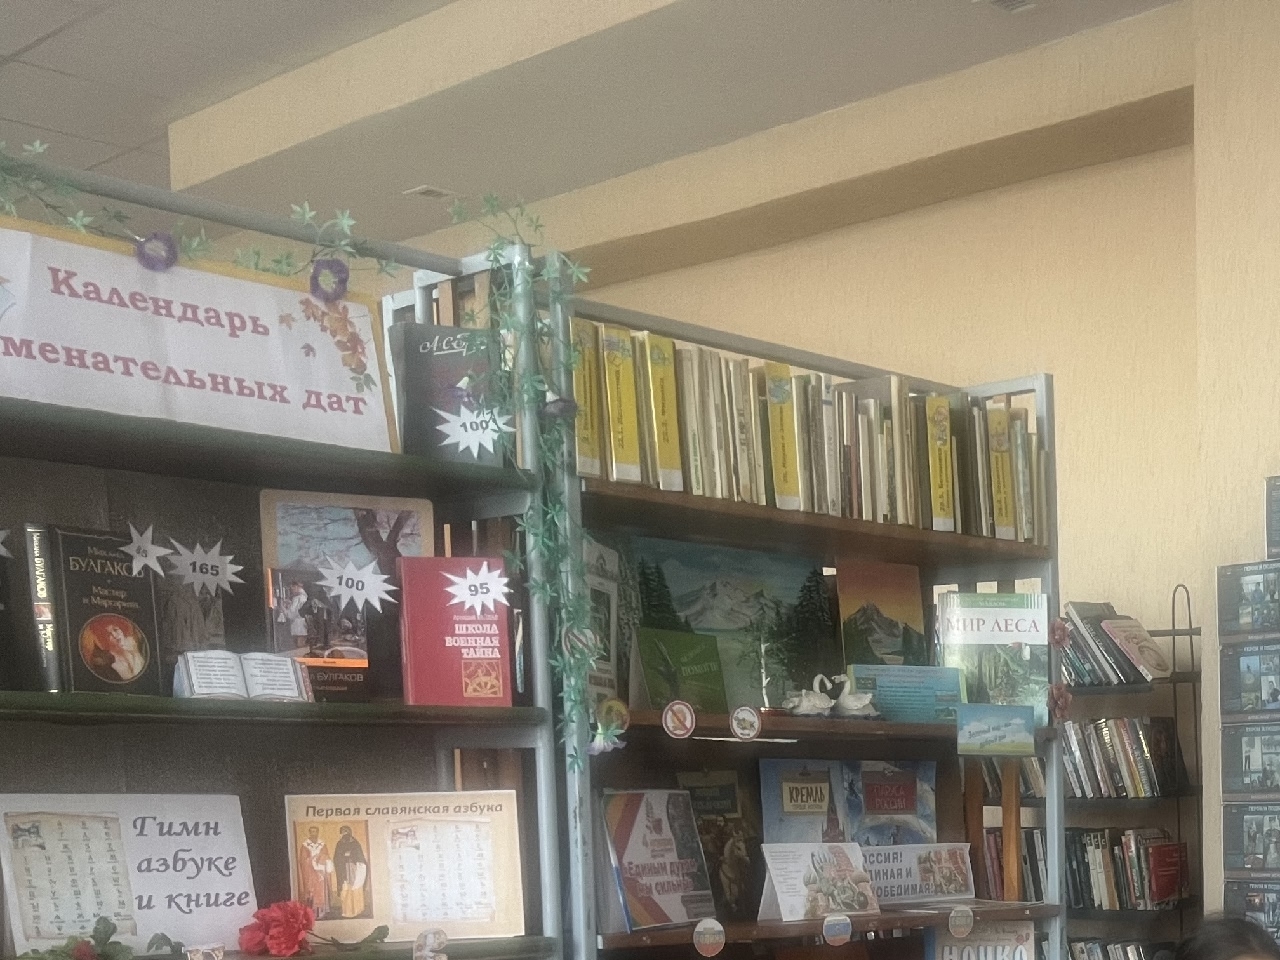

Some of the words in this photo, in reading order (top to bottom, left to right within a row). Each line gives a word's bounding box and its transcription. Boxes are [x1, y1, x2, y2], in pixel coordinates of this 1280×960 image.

[47, 266, 270, 338] Календарь
[302, 389, 367, 415] дат
[460, 420, 489, 434] 100
[69, 556, 144, 578] БУЛГАКВ
[189, 560, 220, 577] 165
[336, 574, 366, 592] 100
[467, 581, 491, 598] 95
[454, 624, 499, 635] ШКОЛА
[946, 617, 985, 632] МИР
[990, 618, 1040, 633] ЛЕСА
[445, 636, 500, 648] ВОЕННАЯ
[461, 647, 501, 659] ТАЙНА
[316, 672, 364, 683] БУЛГАКОВ
[788, 786, 826, 804] КРЕМЛЬ
[305, 805, 361, 819] Первая
[365, 805, 449, 816] славянская
[453, 802, 503, 815] азбука
[133, 815, 221, 837] Гимн
[137, 848, 238, 880] азбуке
[862, 851, 903, 865] ОССИЯ!
[870, 867, 903, 882] ДИНАЯ
[905, 868, 912, 879] И
[873, 882, 934, 898] ОБЕДИМАЯ!
[135, 893, 155, 910] и
[165, 890, 250, 915] книге
